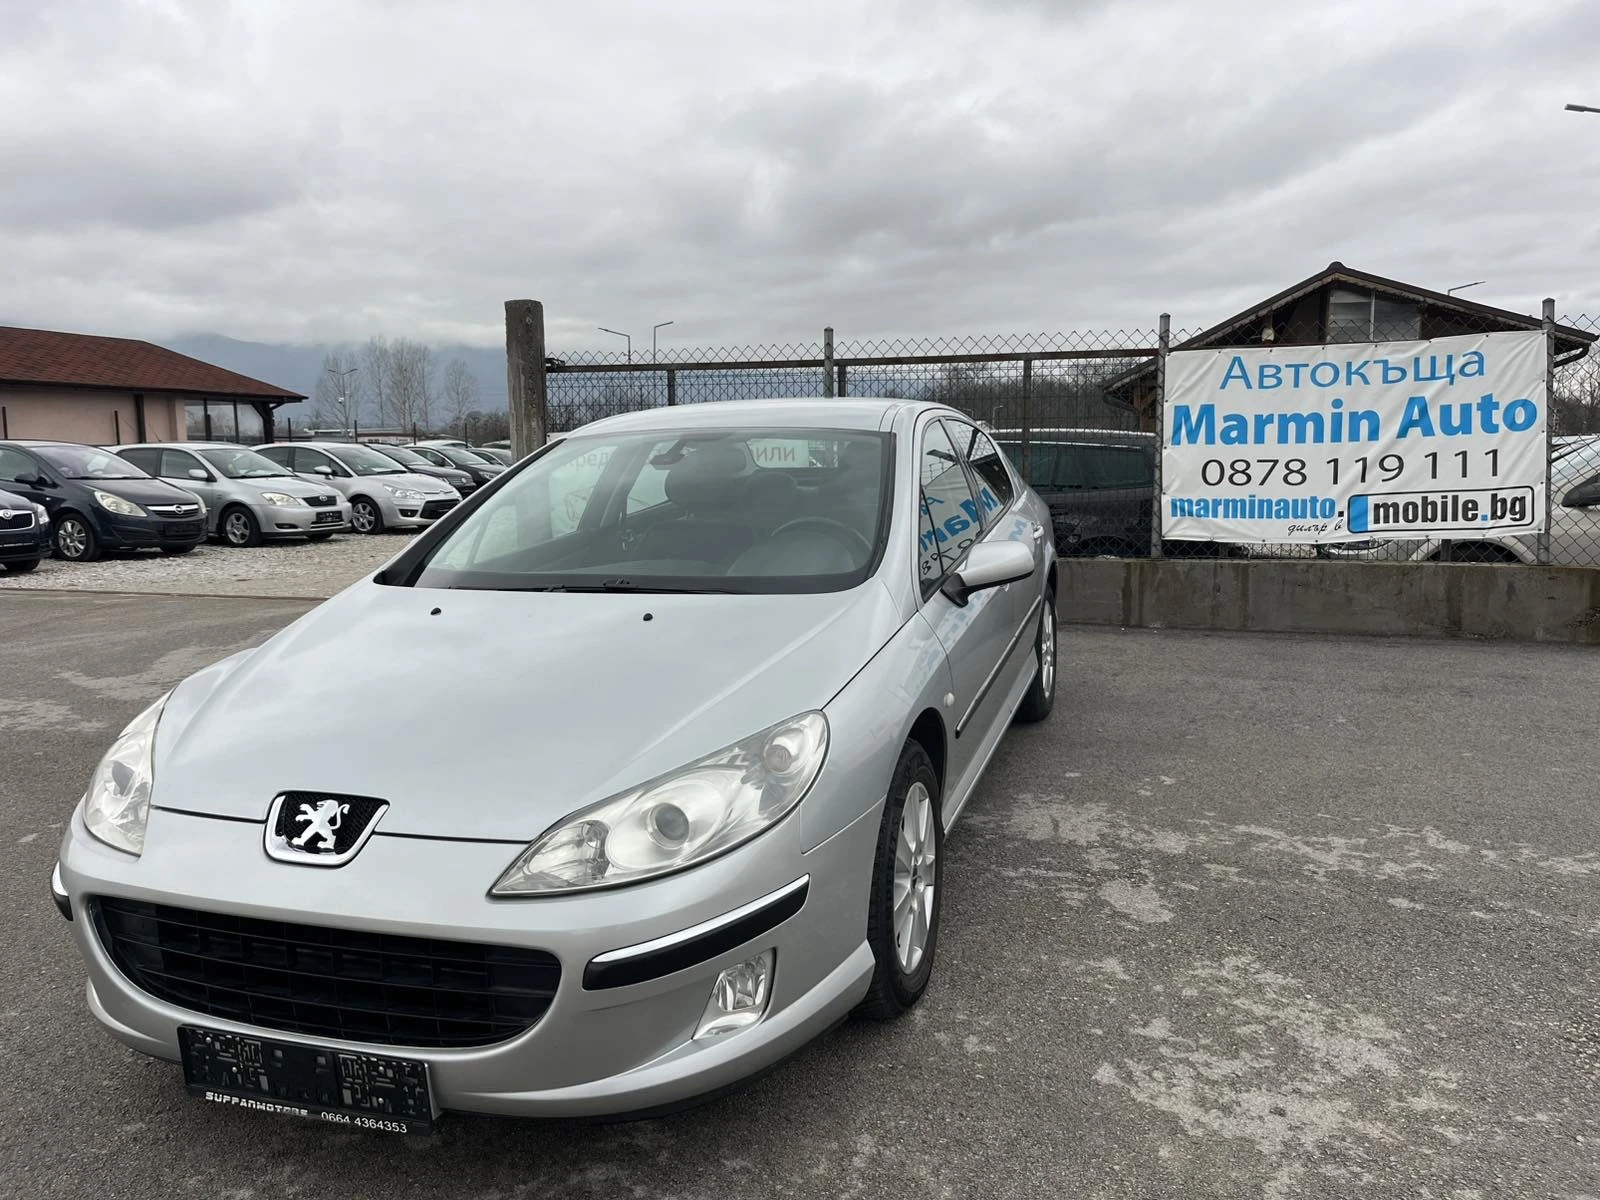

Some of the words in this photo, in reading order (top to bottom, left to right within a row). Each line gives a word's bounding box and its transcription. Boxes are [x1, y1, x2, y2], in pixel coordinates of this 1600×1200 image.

[1219, 350, 1485, 389] Автокъща
[1171, 399, 1381, 446] Marmin
[1396, 392, 1538, 439] Auto
[1201, 458, 1308, 486] 0878
[1327, 453, 1404, 485] 119
[1425, 449, 1499, 480] 111
[1372, 493, 1527, 525] mobile.bg
[321, 1111, 351, 1125] 0664
[354, 1117, 408, 1134] 4364353
